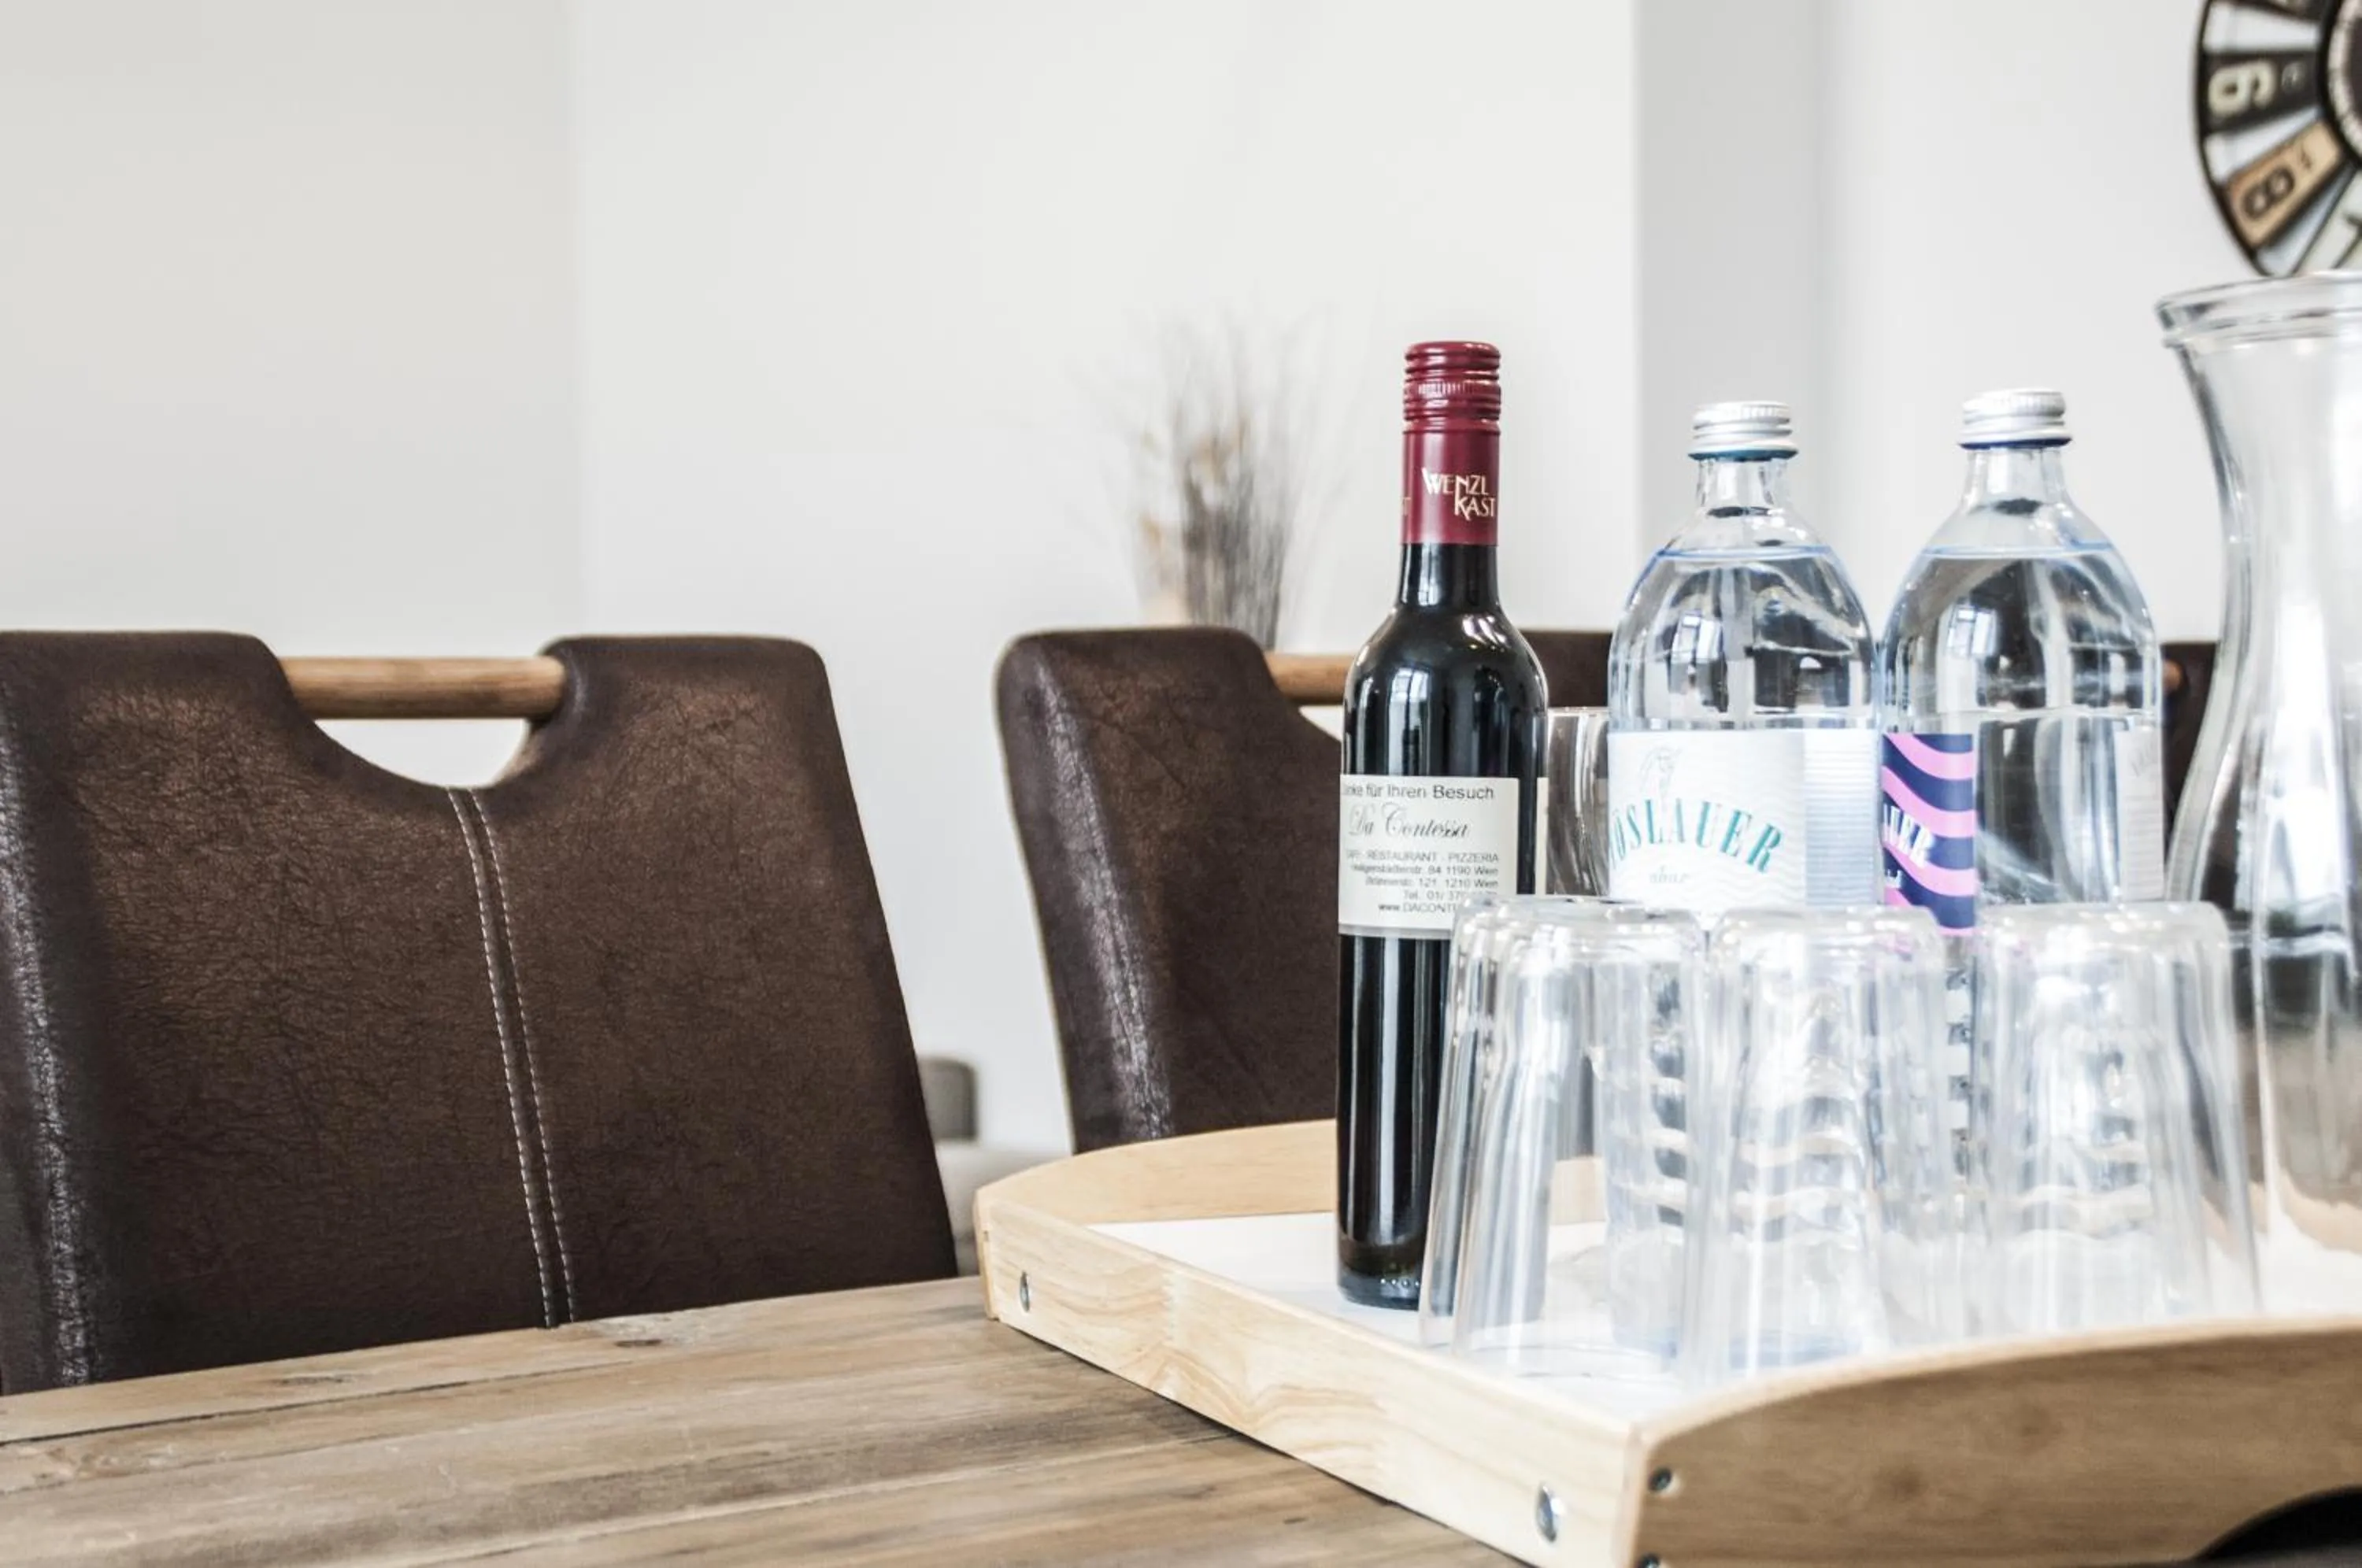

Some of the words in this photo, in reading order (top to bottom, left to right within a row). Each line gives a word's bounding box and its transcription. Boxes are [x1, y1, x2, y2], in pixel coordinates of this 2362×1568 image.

[1421, 467, 1490, 496] WENZL
[1454, 494, 1495, 521] KAST
[1386, 784, 1427, 798] Ihren
[1432, 784, 1495, 800] Besuch
[1609, 797, 1783, 874] ÖSLAUER
[1367, 849, 1438, 863] RESTAURANT
[1447, 851, 1499, 864] PIZZERIA
[1446, 865, 1470, 875] 1190
[1474, 866, 1498, 875] Wien
[1446, 878, 1471, 888] 1210
[1474, 879, 1498, 888] Wien
